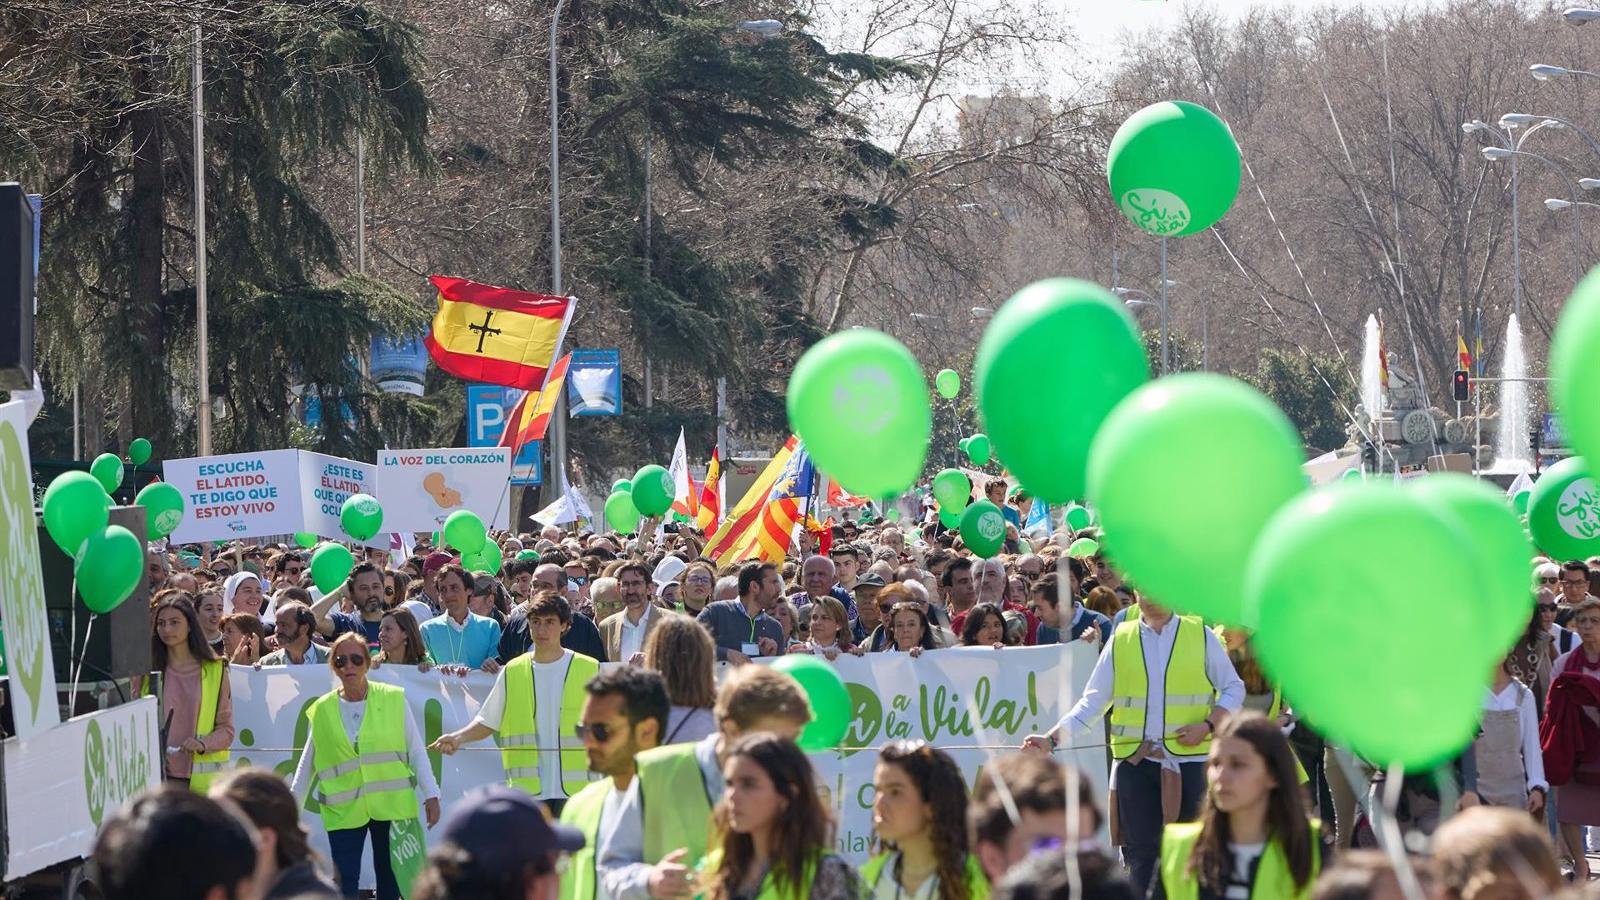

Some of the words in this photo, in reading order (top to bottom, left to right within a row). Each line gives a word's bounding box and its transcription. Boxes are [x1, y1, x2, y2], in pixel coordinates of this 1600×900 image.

[476, 403, 504, 440] P
[198, 459, 265, 476] ESCUCHA
[384, 456, 398, 466] LA
[400, 456, 423, 465] VOZ
[425, 455, 447, 465] DEL
[449, 452, 505, 464] CORAZÓN
[323, 463, 351, 478] ¿ESTE
[352, 468, 364, 481] ES
[196, 479, 213, 491] EL
[215, 474, 270, 490] LATIDO,
[321, 475, 332, 488] EL
[190, 493, 207, 505] TE
[211, 489, 246, 504] DIGO
[248, 486, 278, 501] QUE
[314, 488, 334, 502] QUE
[195, 504, 240, 519] ESTOY
[240, 501, 275, 515] VIVO
[892, 693, 912, 711] a
[919, 671, 1039, 743] Vida!
[885, 711, 914, 739] la
